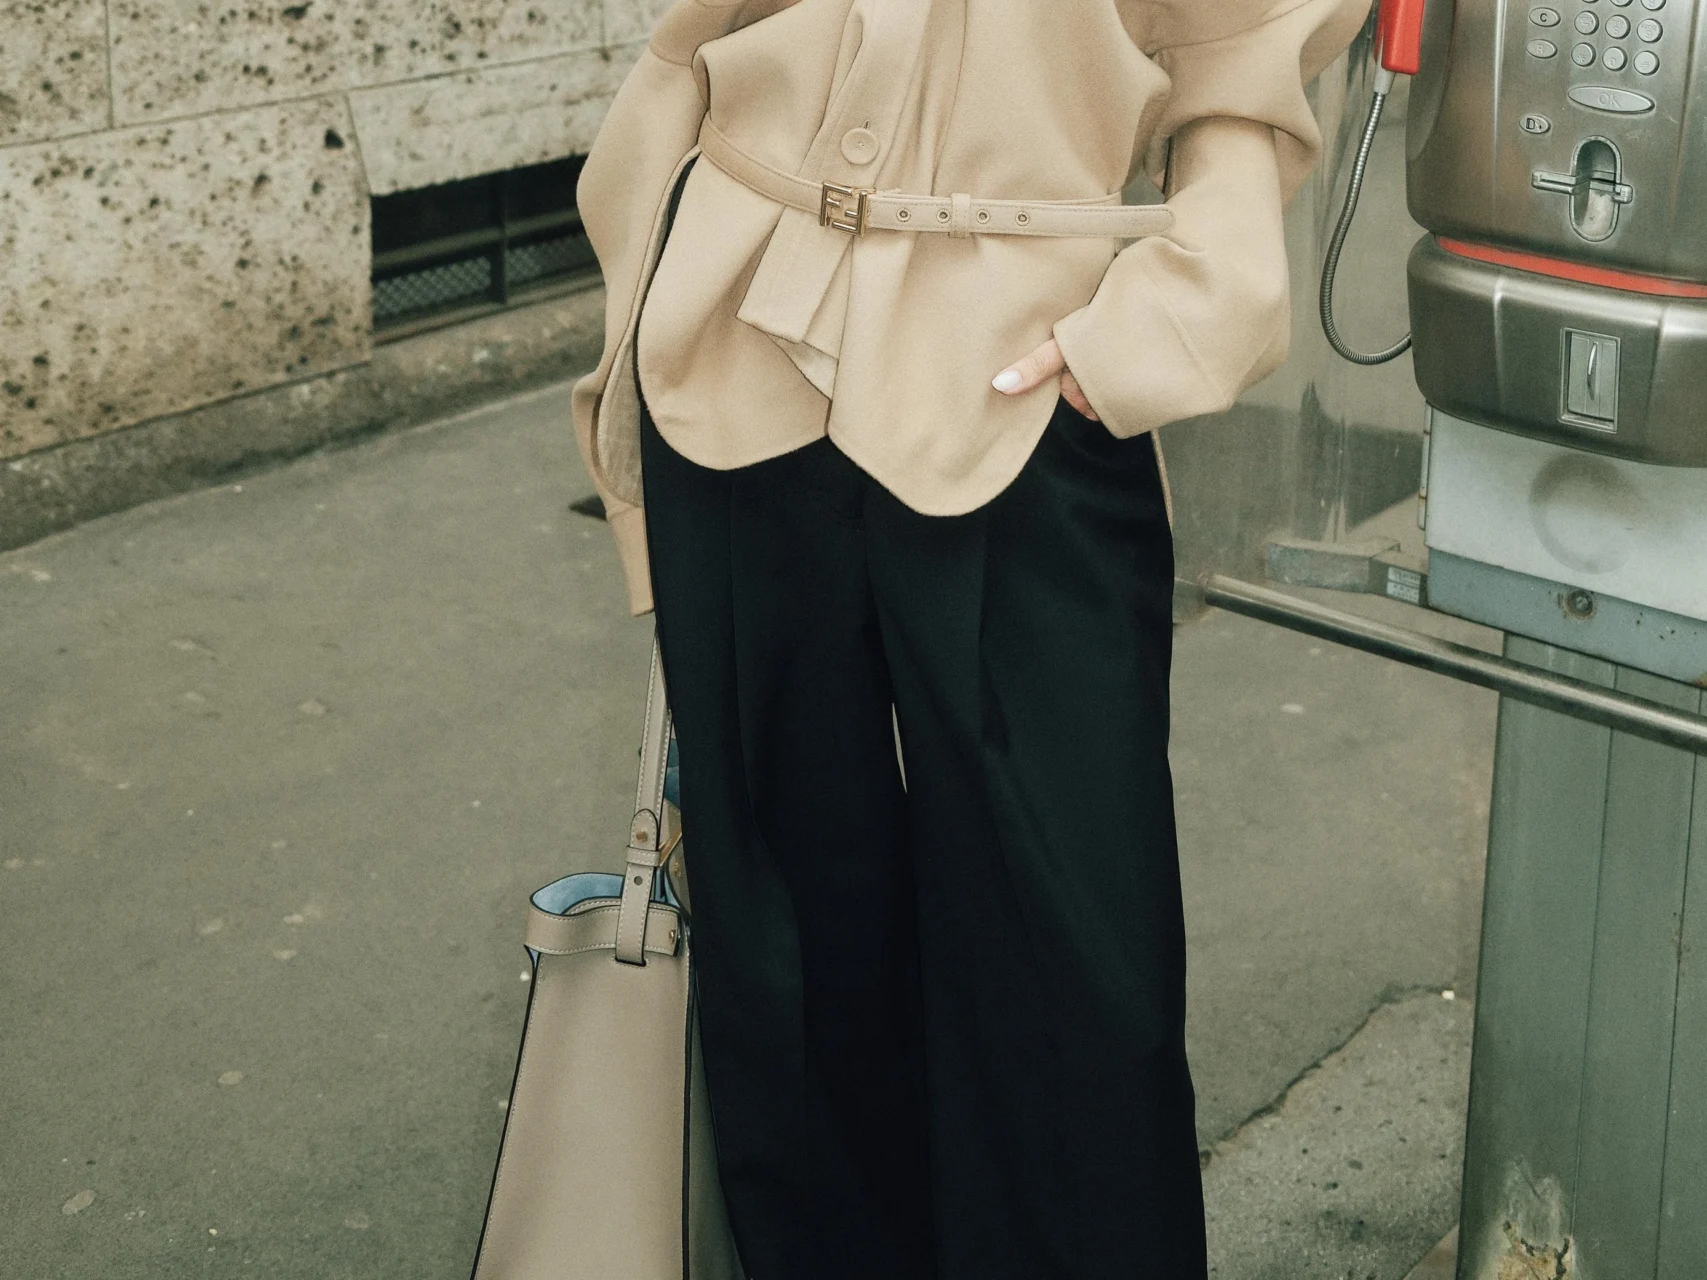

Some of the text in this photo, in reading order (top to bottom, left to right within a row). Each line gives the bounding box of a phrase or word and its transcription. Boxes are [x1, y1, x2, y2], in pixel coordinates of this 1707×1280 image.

[1540, 12, 1548, 22] C
[1536, 44, 1544, 54] R
[1598, 91, 1622, 109] OK
